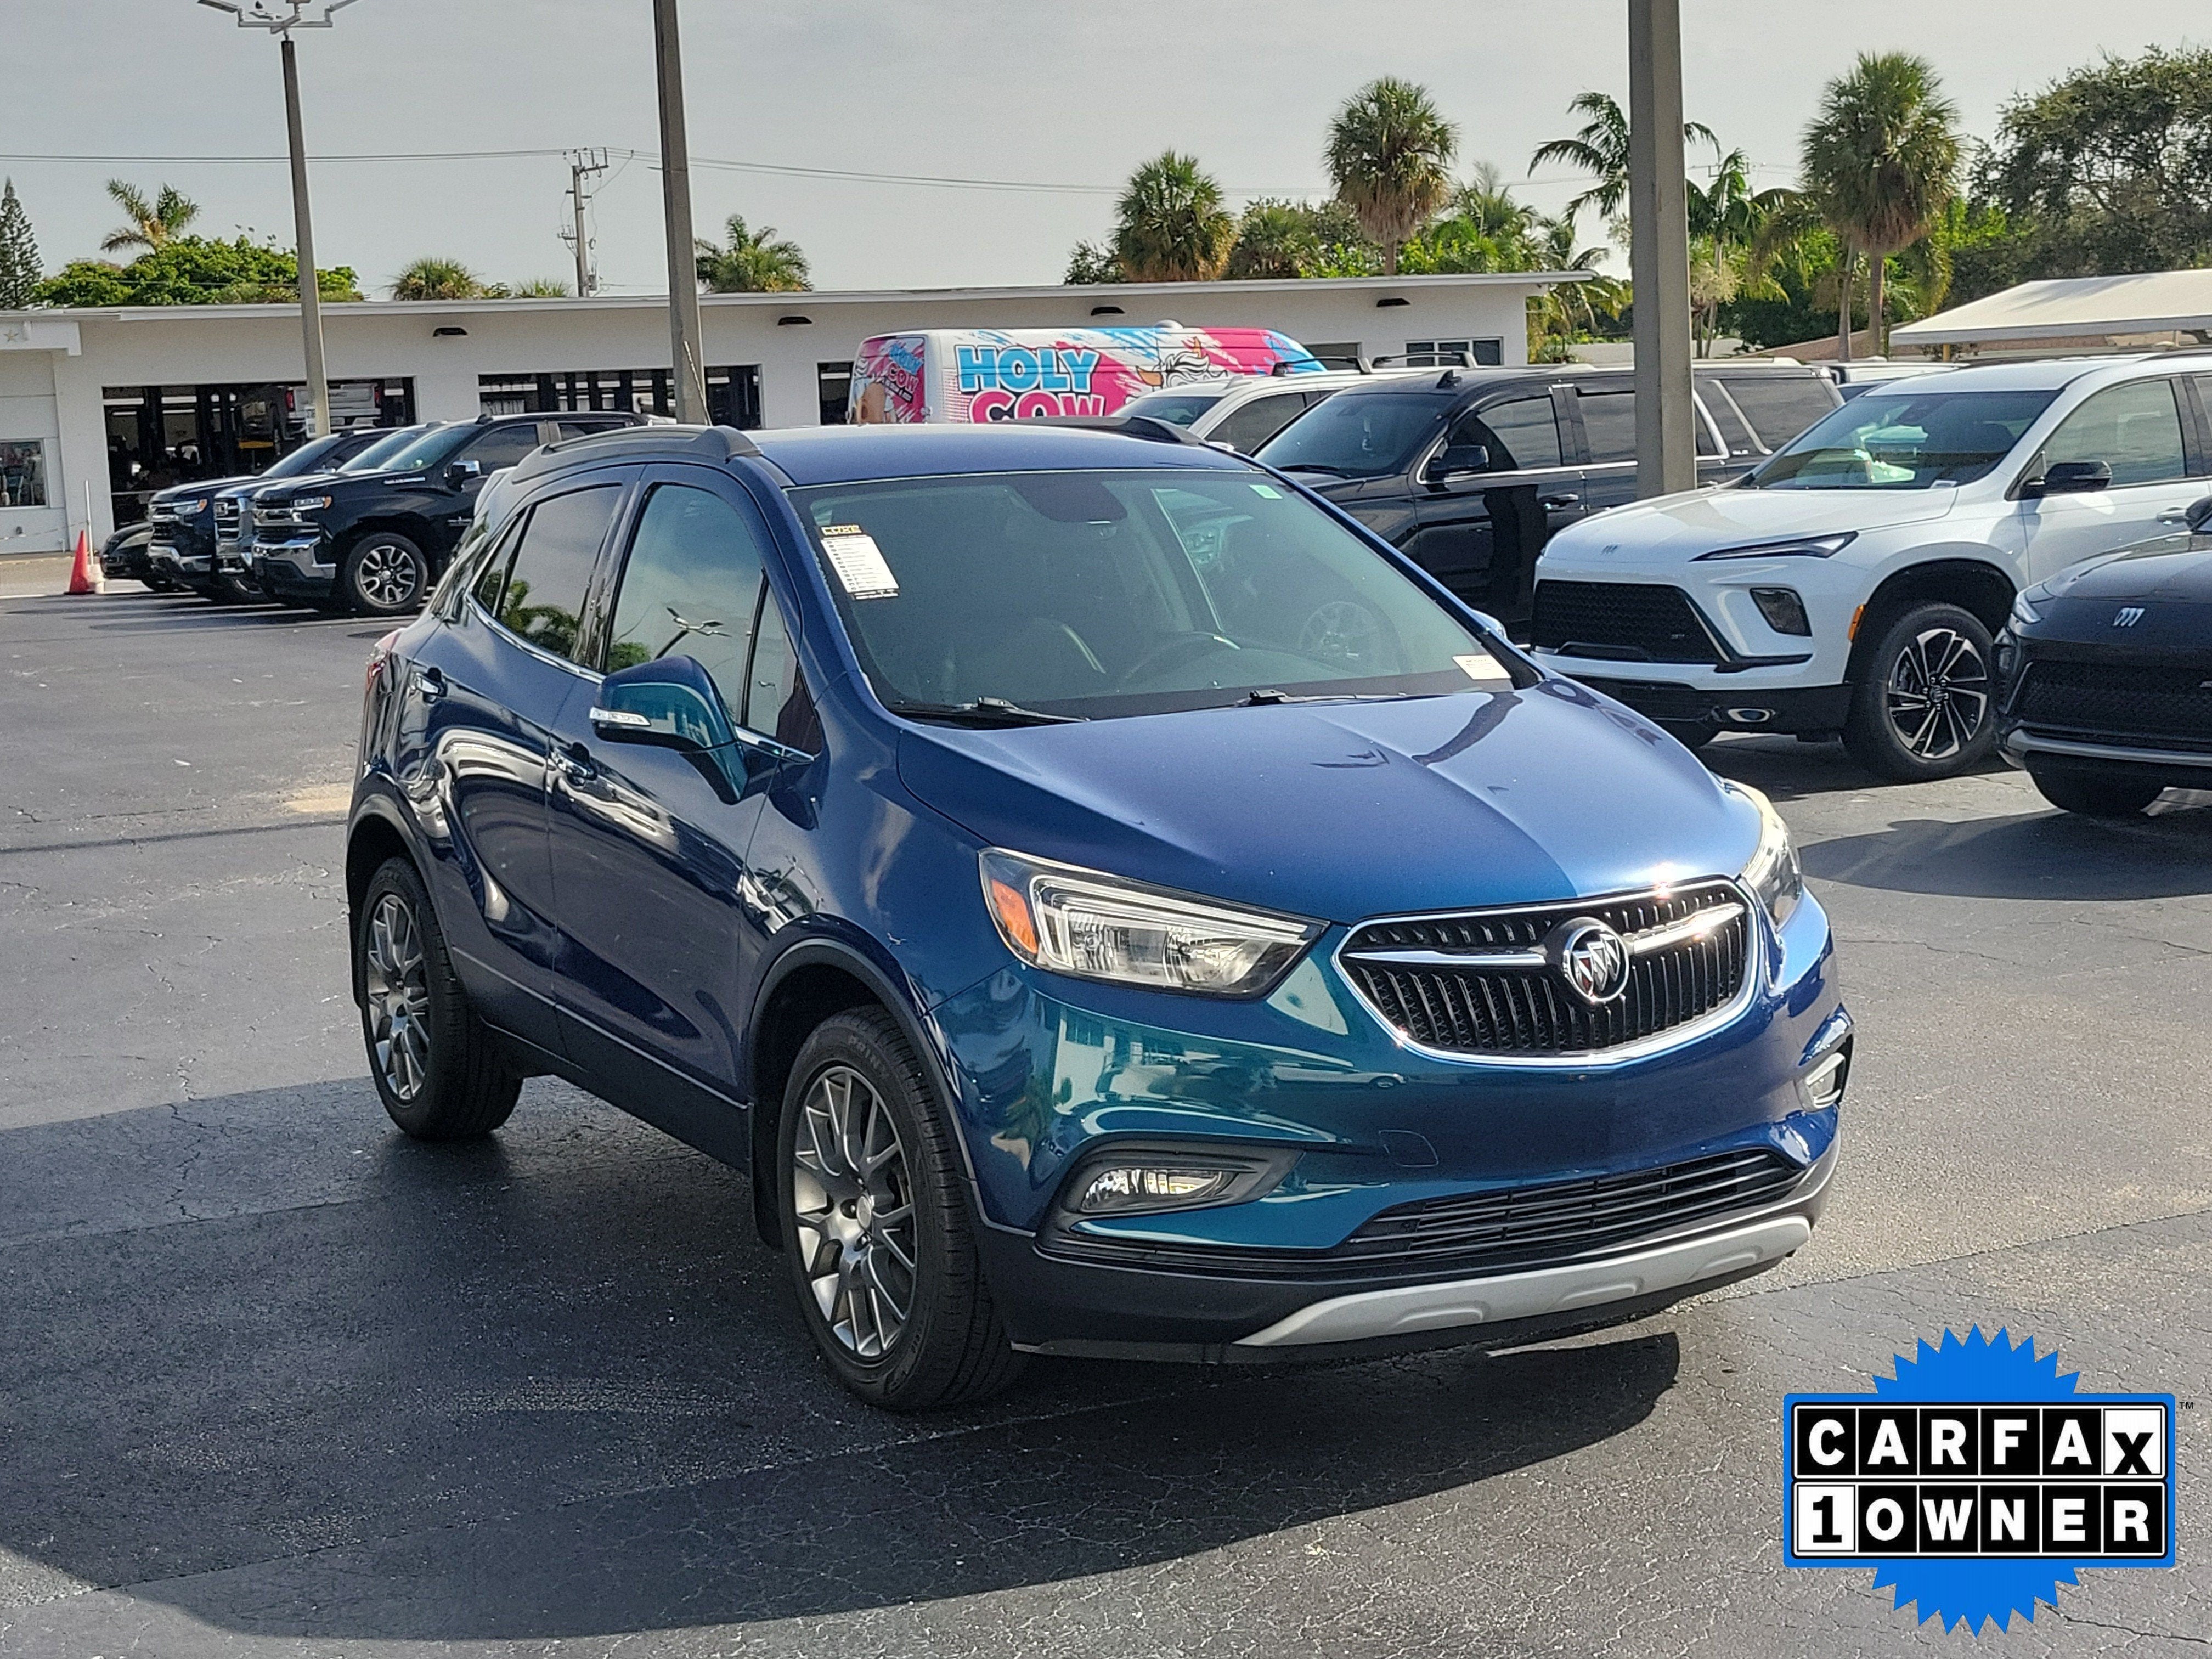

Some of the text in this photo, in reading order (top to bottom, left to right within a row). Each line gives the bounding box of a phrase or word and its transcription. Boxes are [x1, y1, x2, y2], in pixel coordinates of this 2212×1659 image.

[888, 362, 919, 394] COW
[956, 346, 1099, 392] HOLY
[969, 390, 1104, 423] COW
